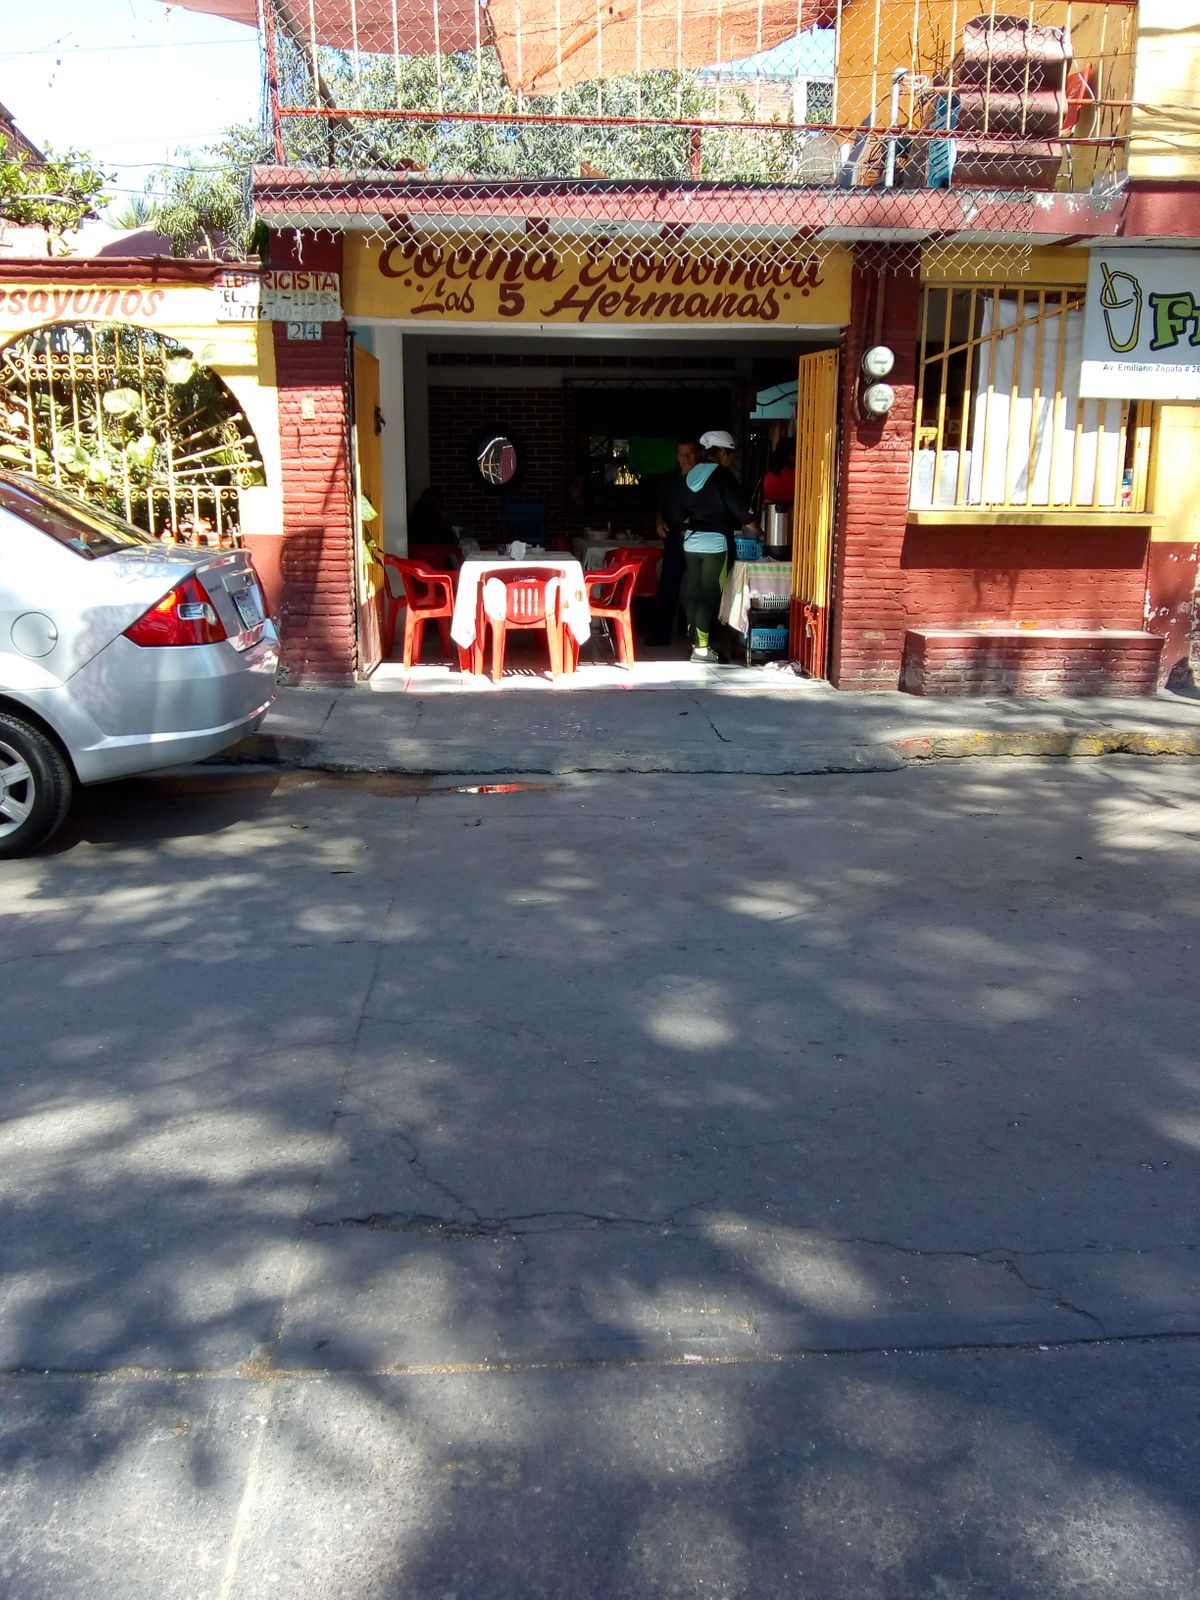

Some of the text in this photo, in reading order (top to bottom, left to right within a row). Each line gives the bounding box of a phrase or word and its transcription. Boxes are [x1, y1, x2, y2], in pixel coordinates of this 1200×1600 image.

[378, 234, 564, 283] Cocina
[410, 278, 780, 322] Las 5 Hermanas
[1117, 364, 1153, 372] Emiliano
[1155, 365, 1183, 373] Zapata
